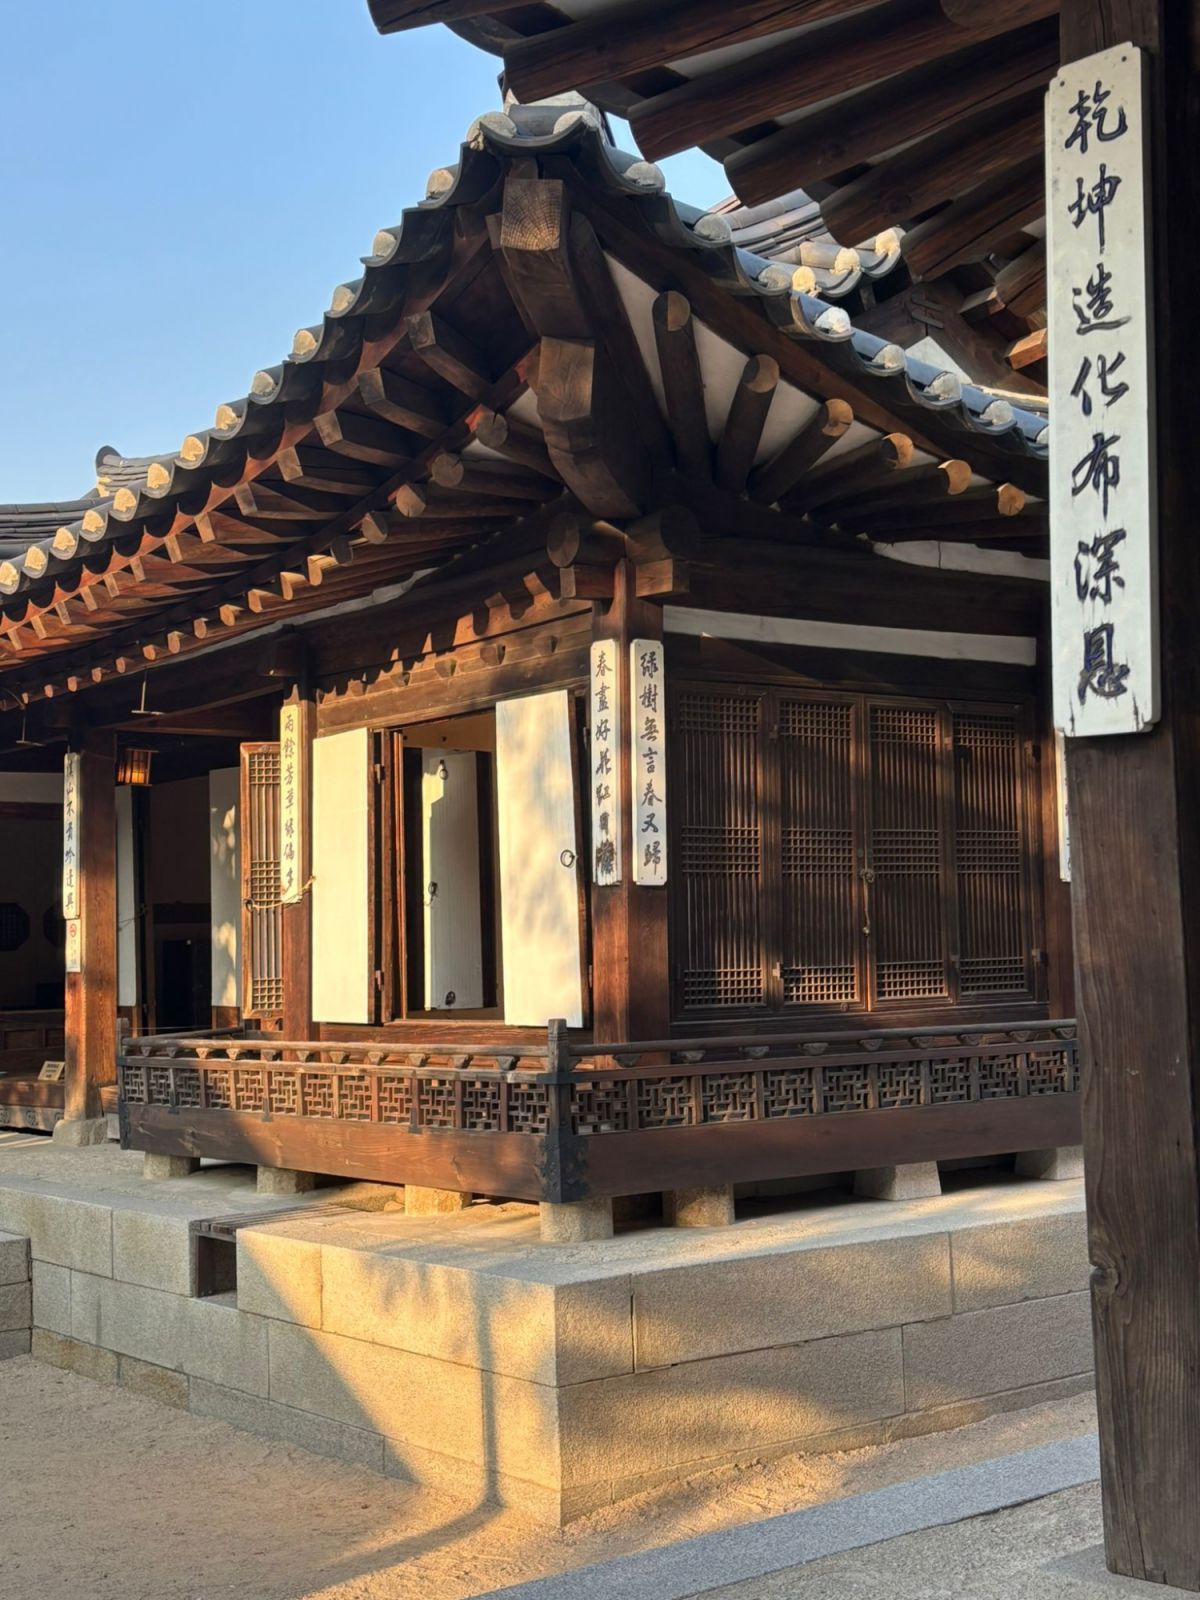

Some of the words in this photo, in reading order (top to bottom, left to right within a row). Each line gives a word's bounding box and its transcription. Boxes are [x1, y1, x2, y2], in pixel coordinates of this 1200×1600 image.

[639, 651, 662, 875] 綠樹無言春又歸
